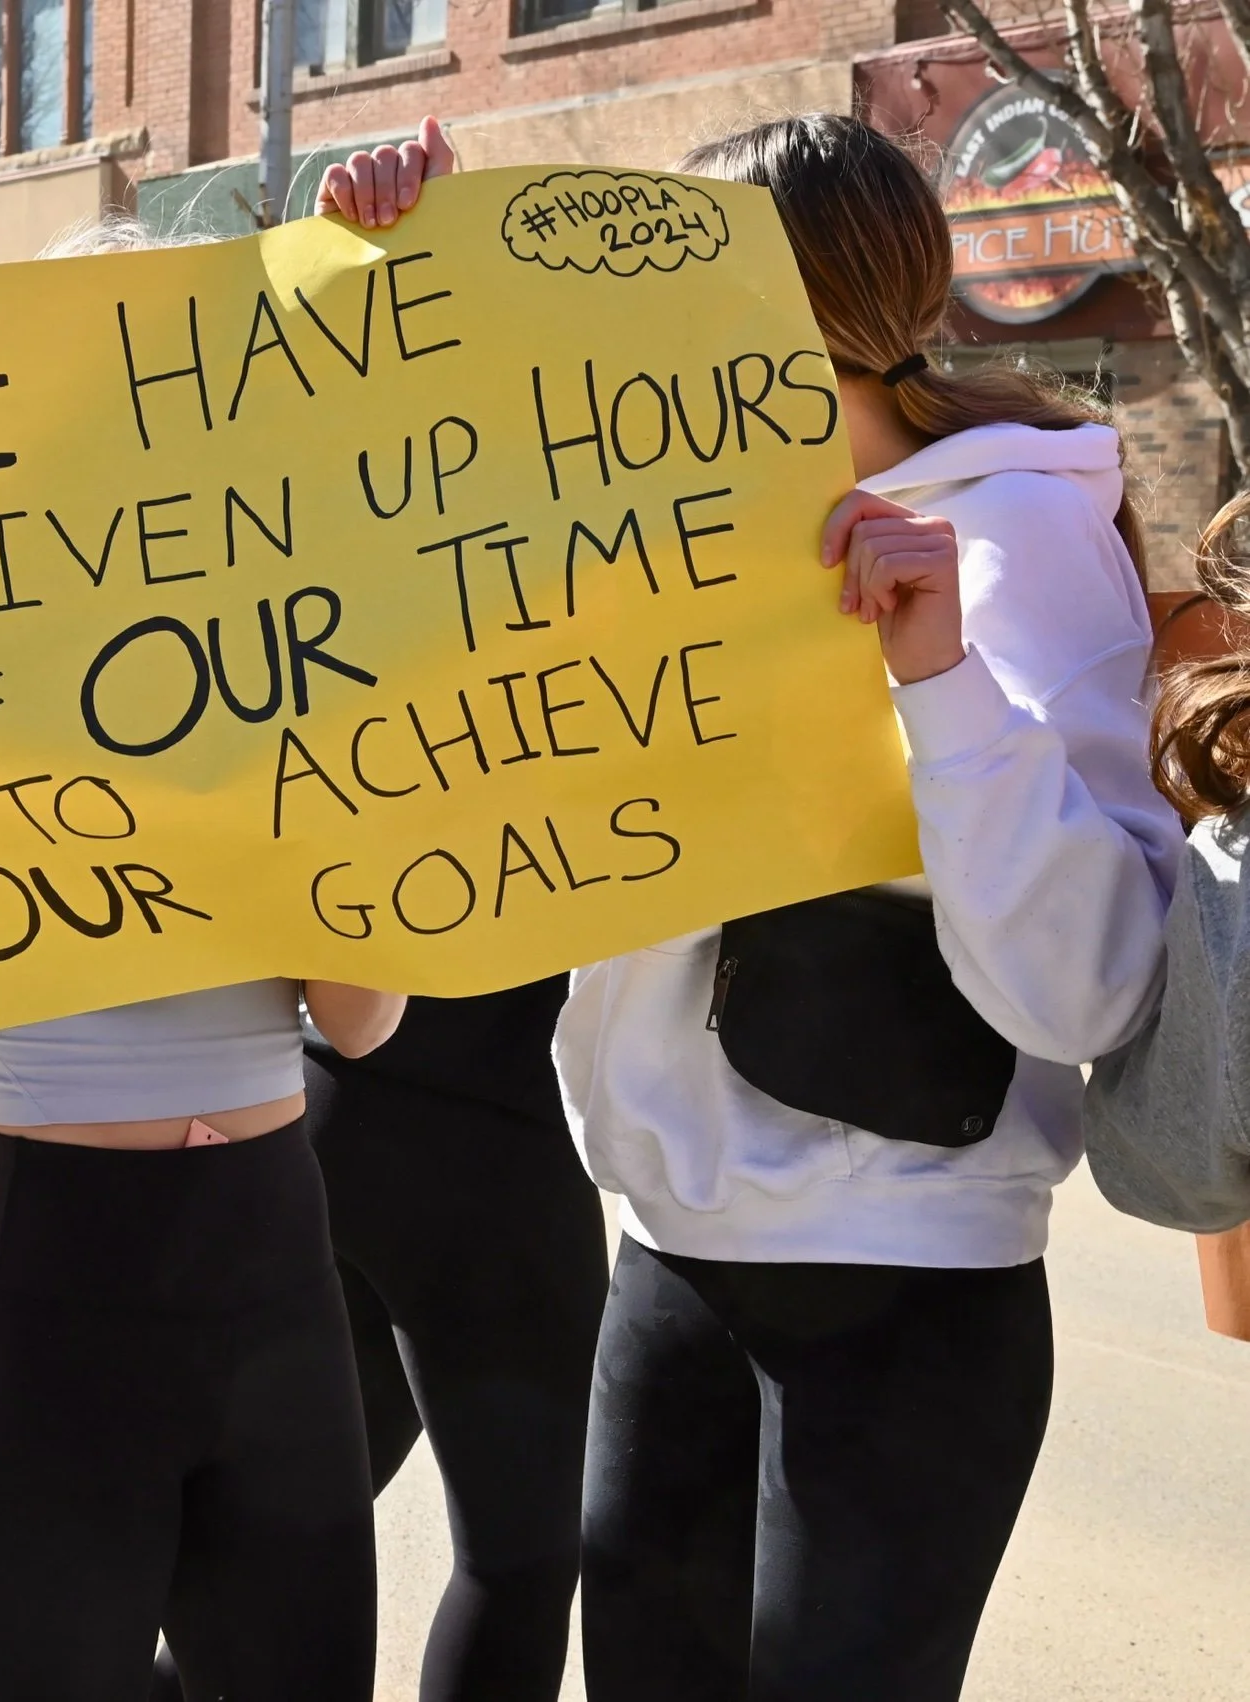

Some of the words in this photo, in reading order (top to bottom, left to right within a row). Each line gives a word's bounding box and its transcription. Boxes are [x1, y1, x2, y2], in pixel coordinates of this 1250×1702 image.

[521, 186, 680, 242] #HOOPLA
[955, 129, 986, 178] EAST
[985, 96, 1046, 133] INDIAN
[600, 211, 709, 252] 2024
[118, 252, 461, 450] HAVE
[358, 416, 477, 519] UP
[532, 350, 837, 500] HOURS
[80, 586, 378, 756] OUR
[417, 488, 737, 652] TIME
[274, 641, 737, 838] ACHIEVE
[311, 797, 680, 939] GOALS
